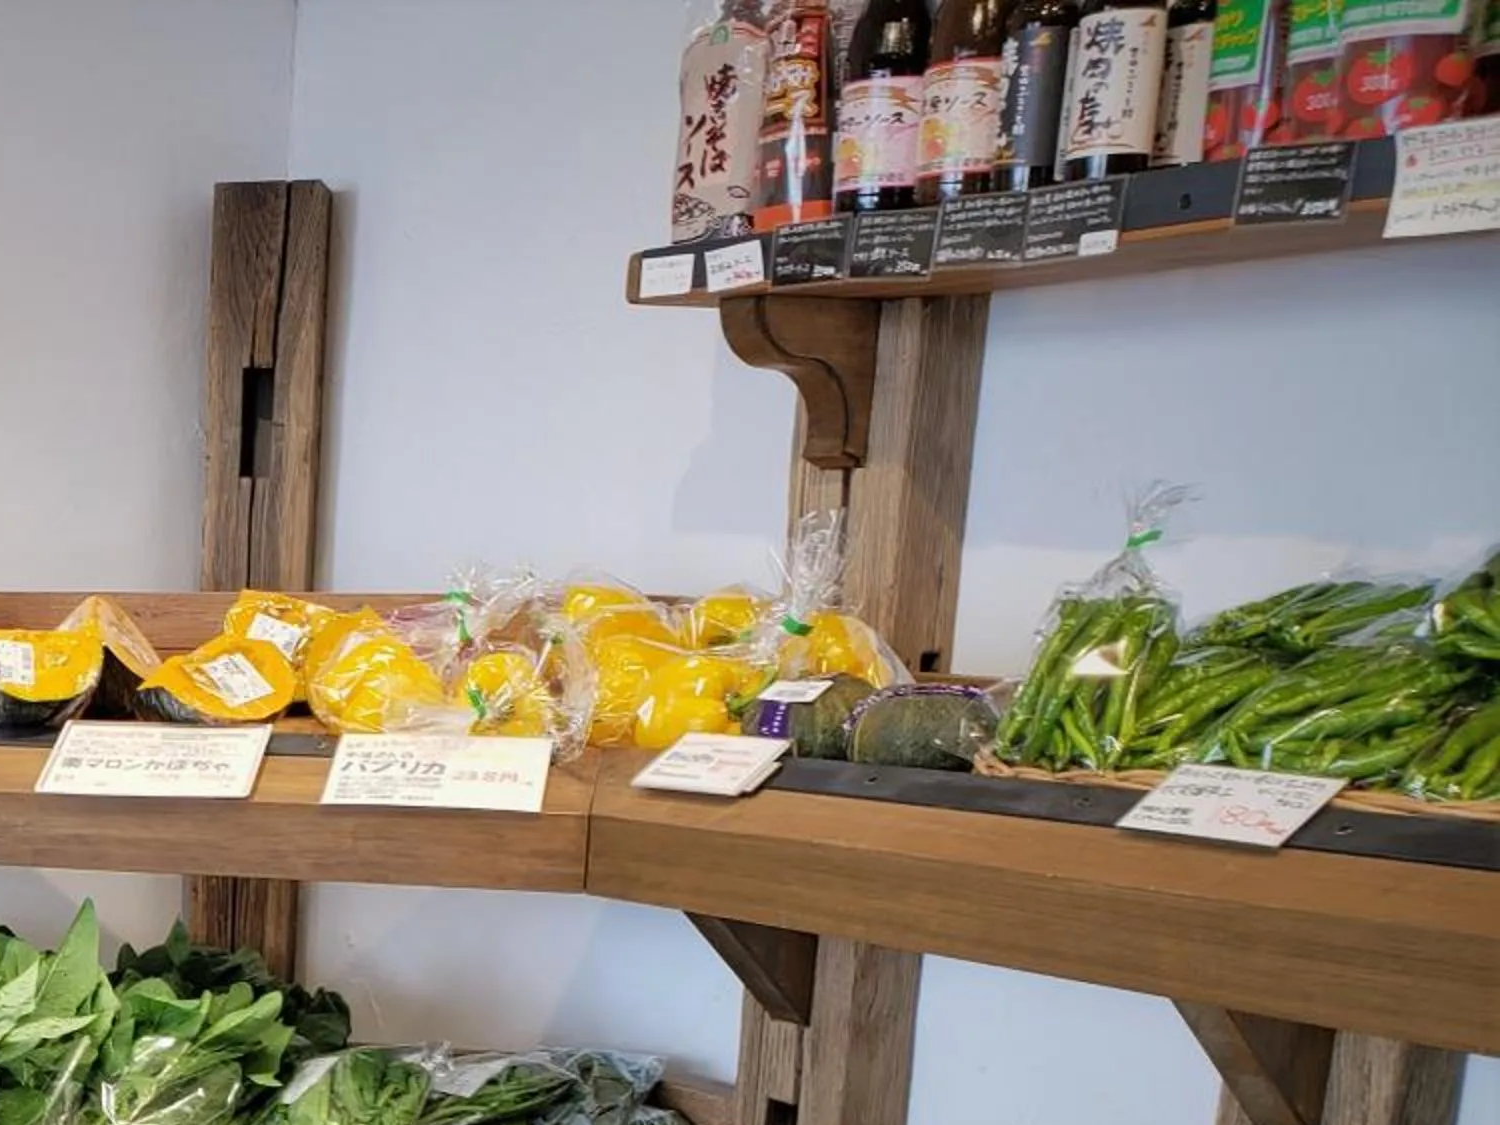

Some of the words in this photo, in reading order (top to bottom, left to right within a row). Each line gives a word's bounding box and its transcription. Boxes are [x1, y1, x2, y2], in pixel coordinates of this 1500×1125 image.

[678, 114, 706, 189] ソース
[702, 63, 738, 178] 焼きそば
